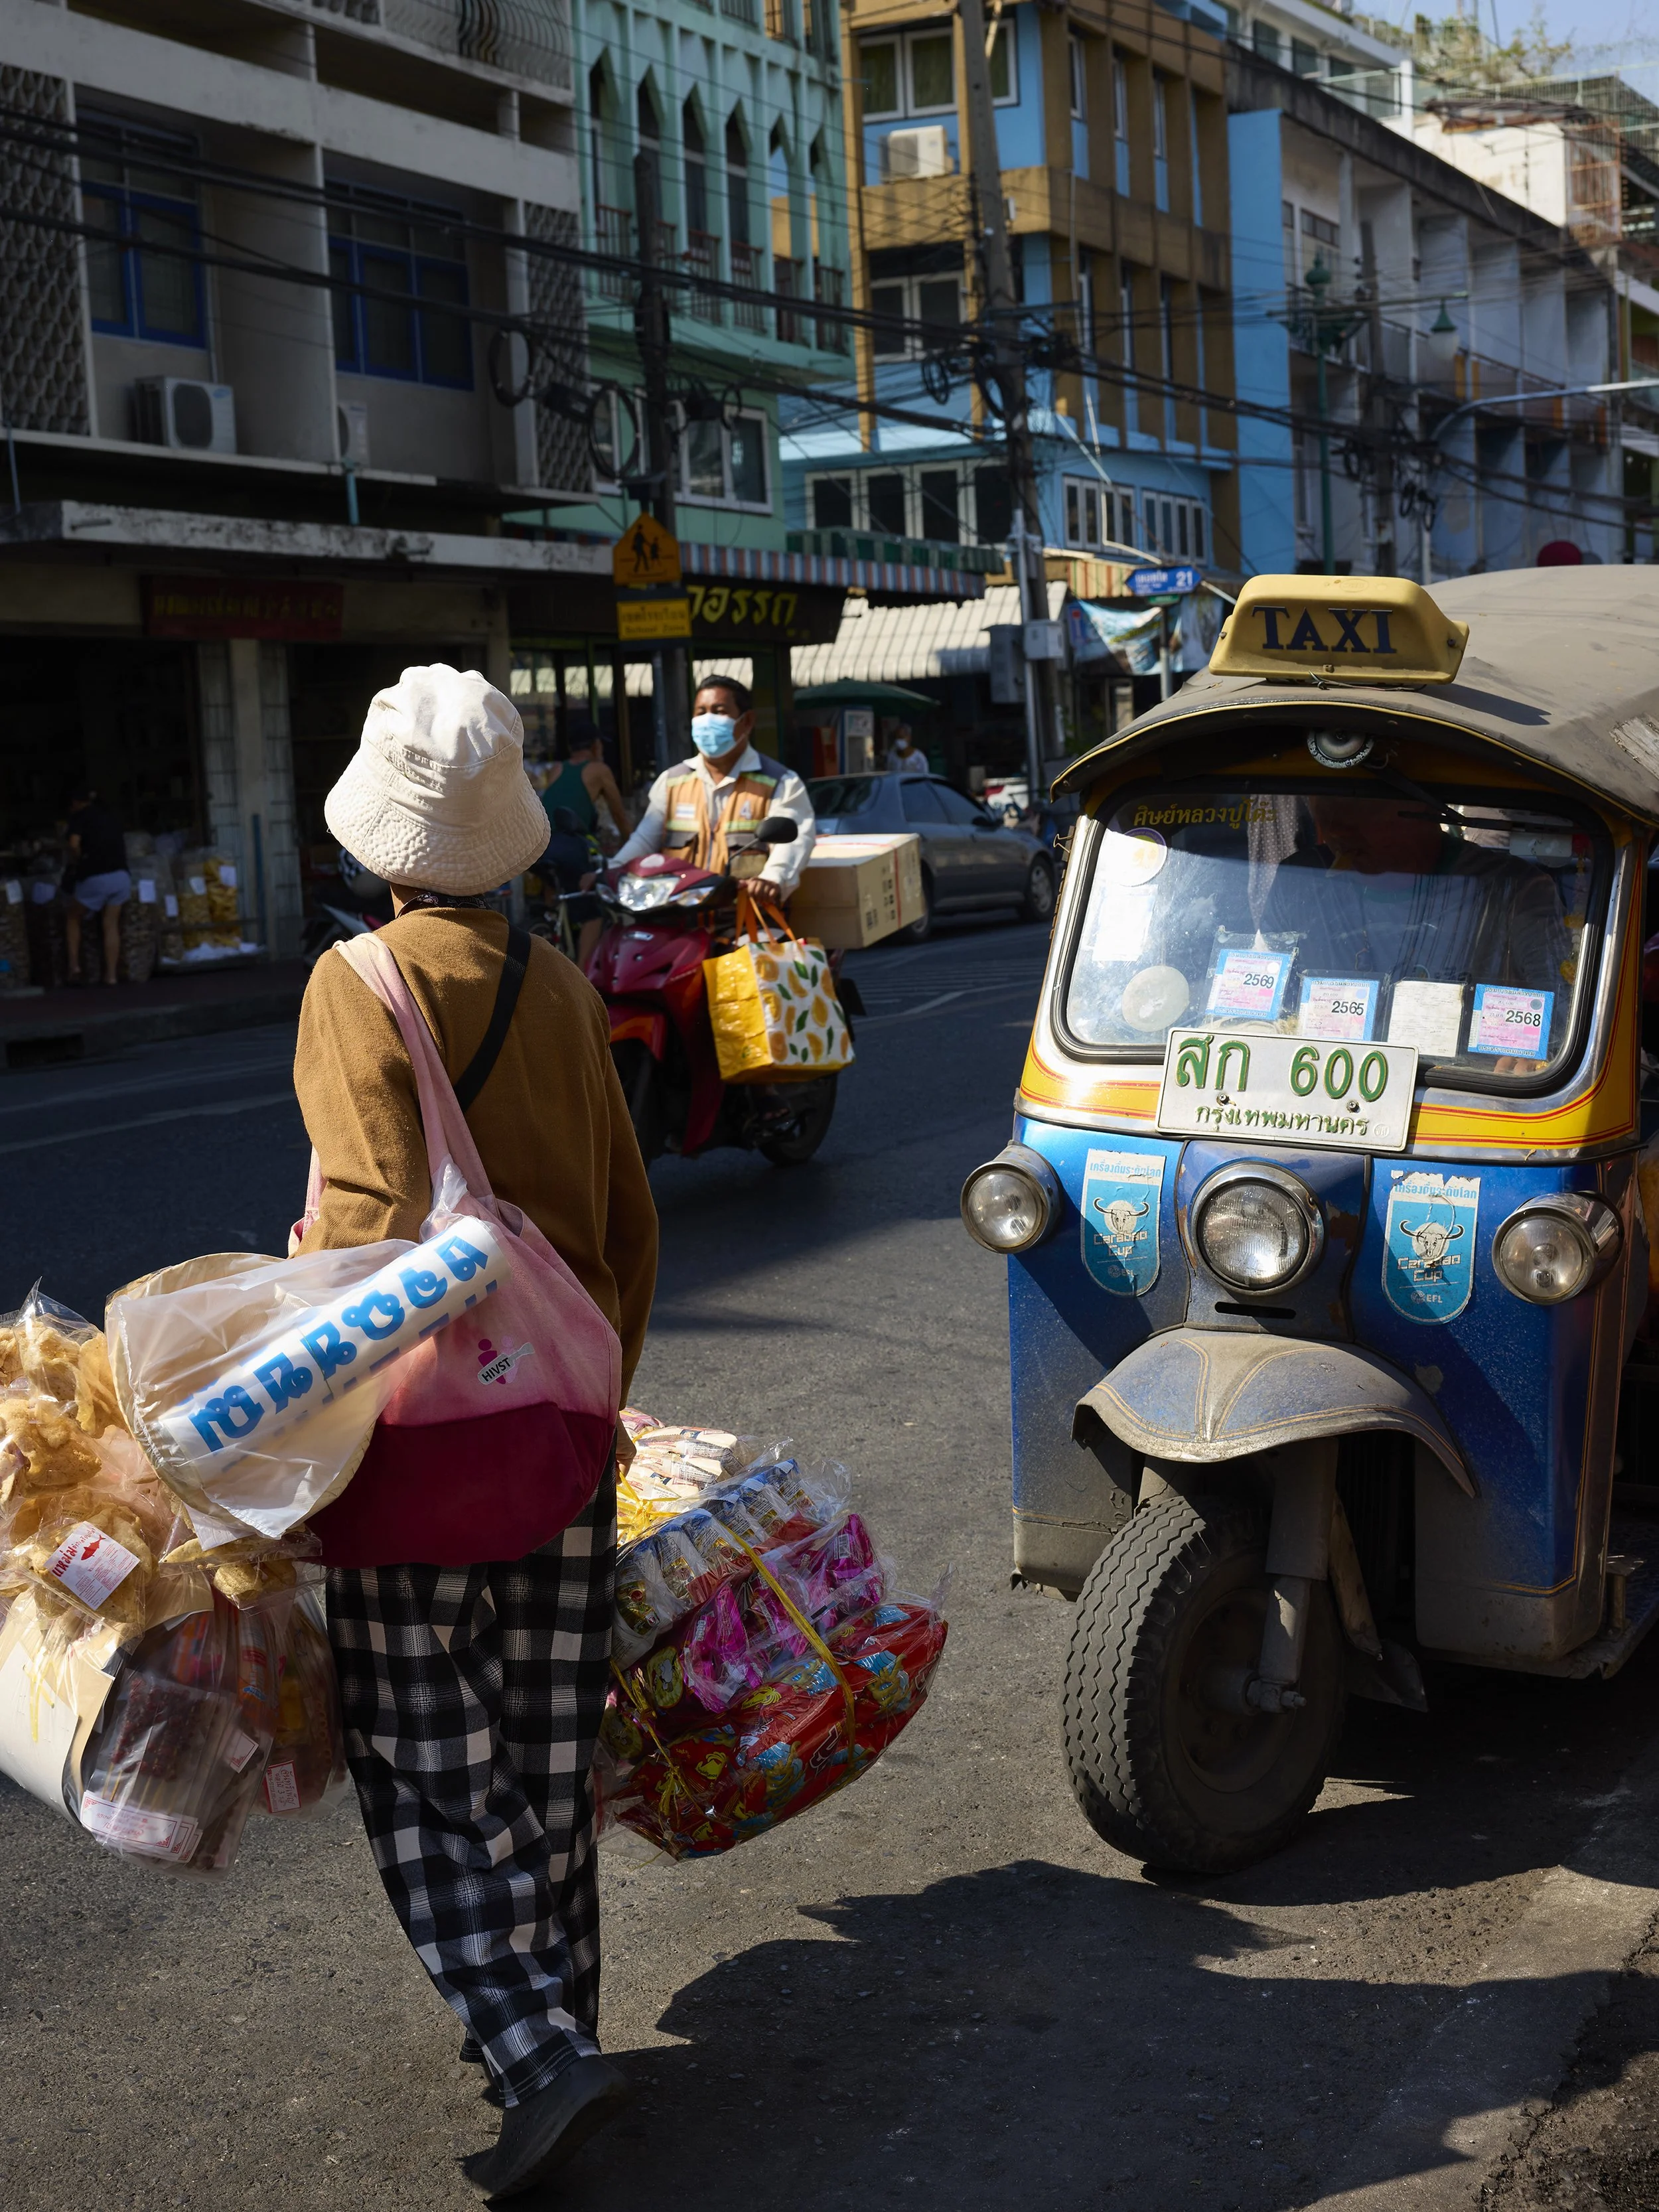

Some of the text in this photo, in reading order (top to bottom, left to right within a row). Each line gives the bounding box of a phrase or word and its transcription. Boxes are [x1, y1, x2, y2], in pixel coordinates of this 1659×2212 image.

[1176, 571, 1192, 587] 21
[1252, 605, 1398, 654] TAXI
[740, 800, 753, 820] 4
[1243, 973, 1274, 989] 2569
[1331, 1000, 1364, 1015] 2565
[1505, 1009, 1541, 1027] 2568
[1176, 1035, 1388, 1102] สก 600
[1194, 1104, 1368, 1136] กรุงเทพมหานคร
[1094, 1230, 1148, 1246] Carabao
[1108, 1244, 1133, 1258] Cup
[1413, 1269, 1443, 1282] Cup
[1427, 1293, 1443, 1303] EFL
[481, 1357, 511, 1382] HIVST
